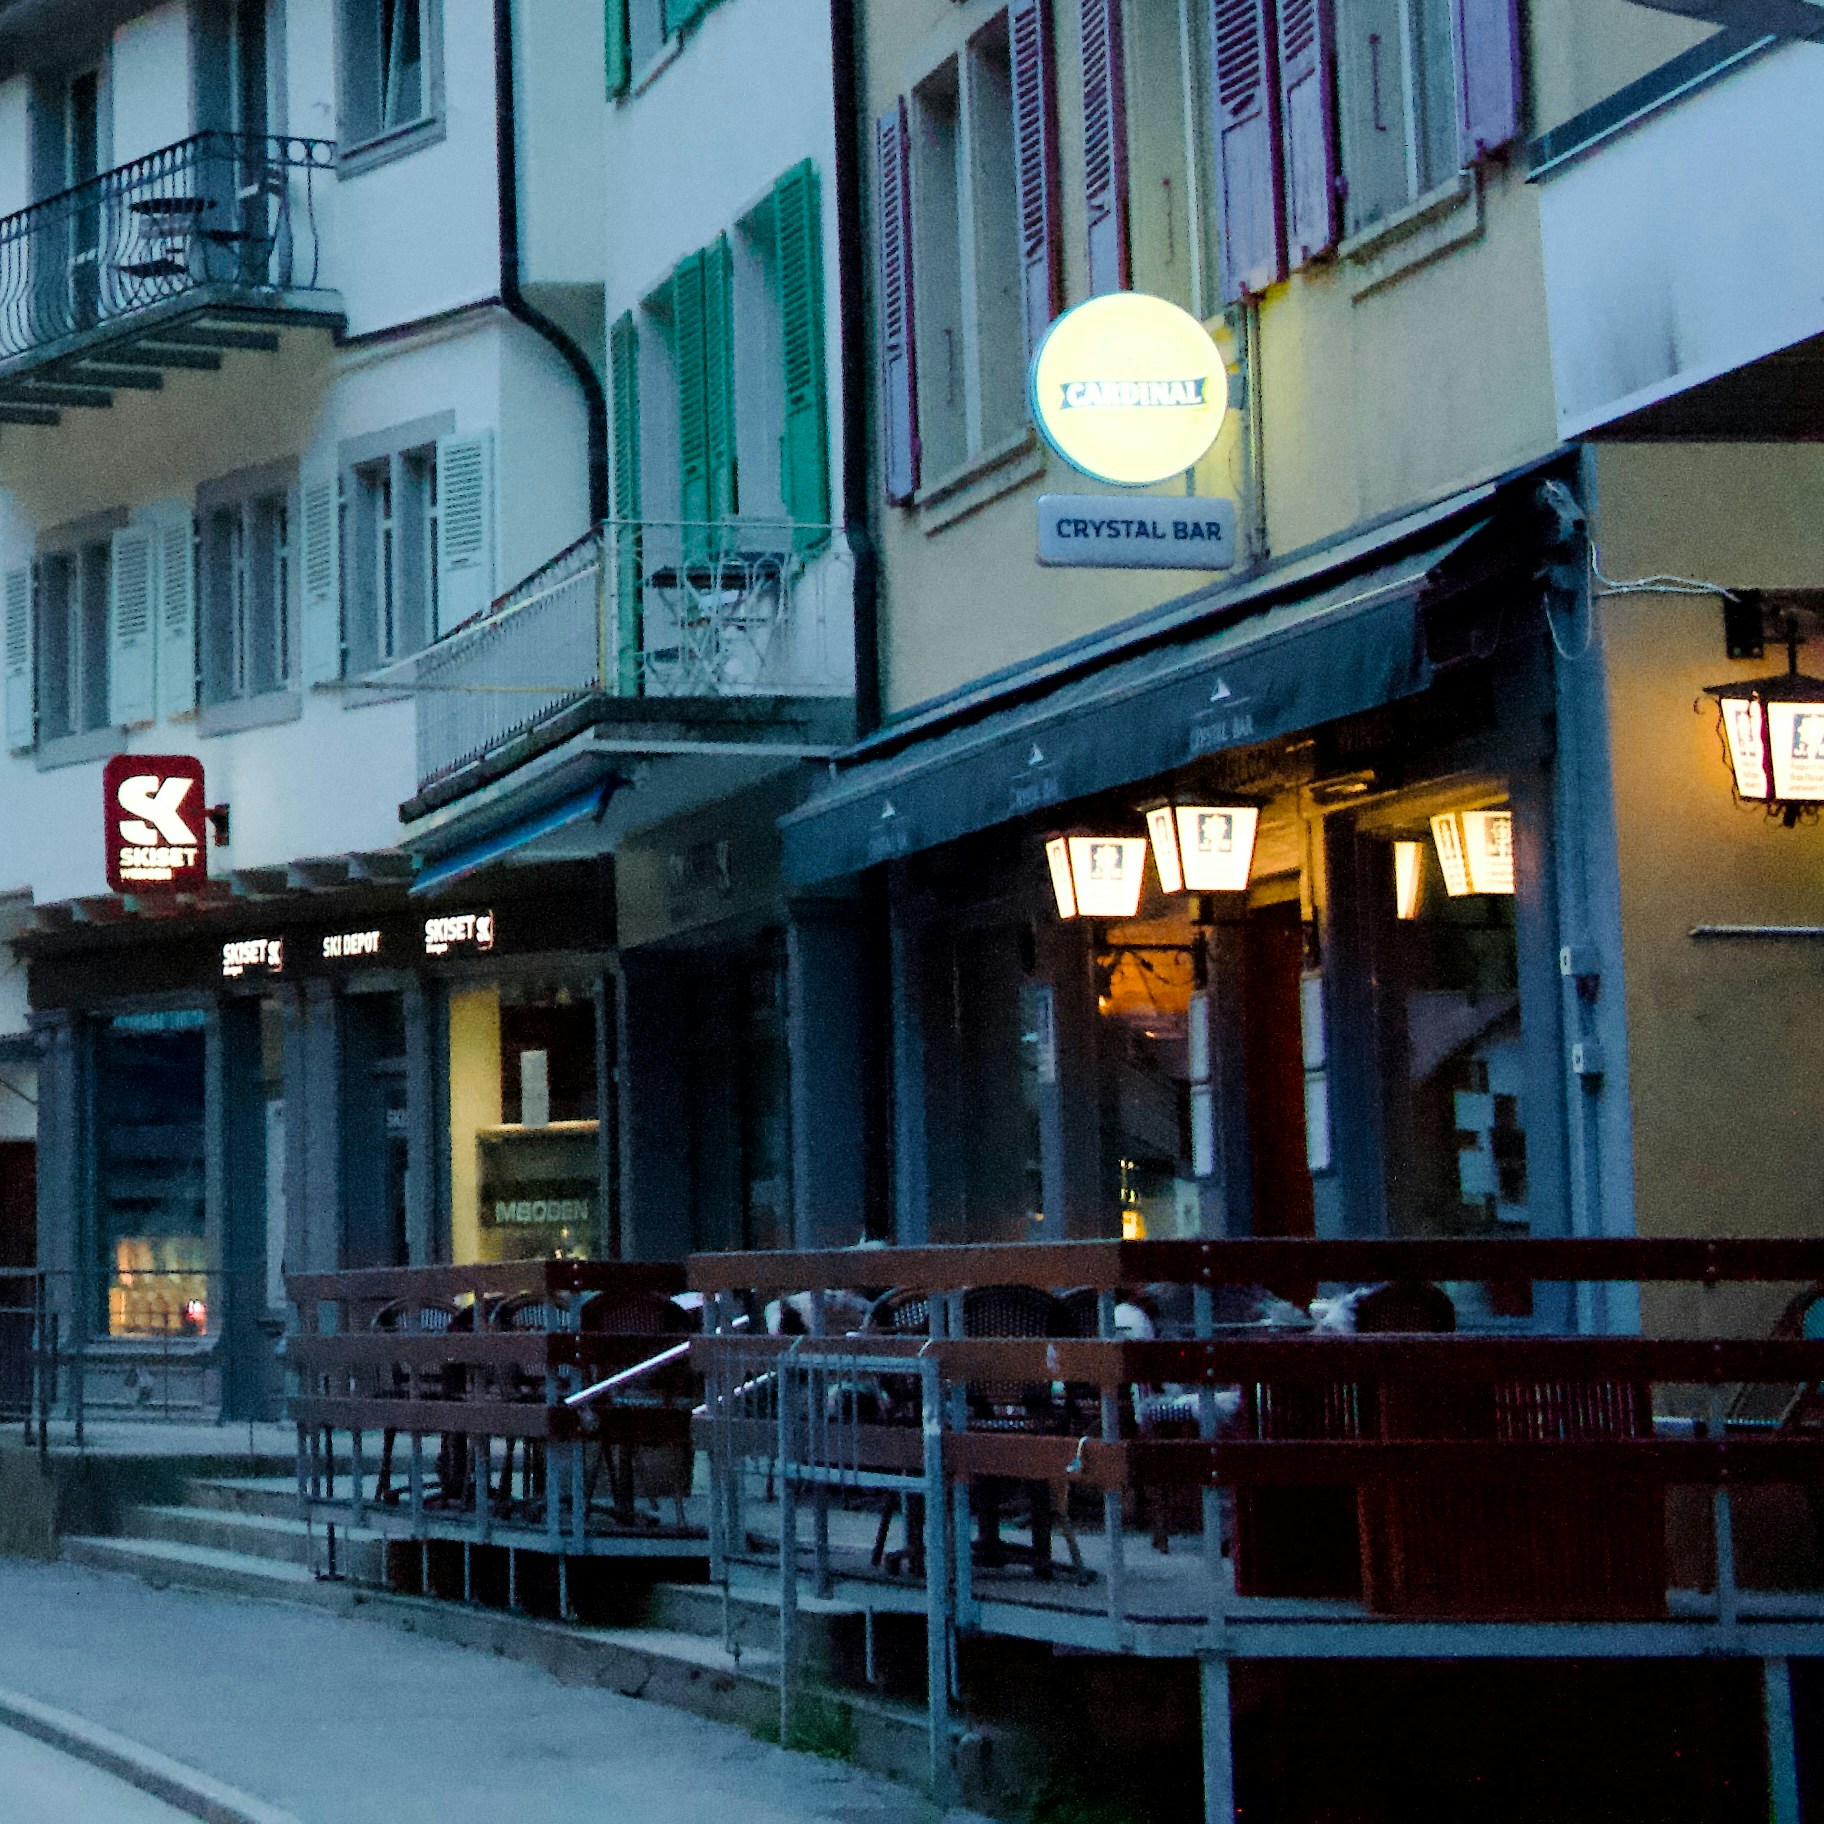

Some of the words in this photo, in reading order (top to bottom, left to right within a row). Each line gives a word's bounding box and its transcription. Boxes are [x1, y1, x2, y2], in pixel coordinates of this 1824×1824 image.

[1066, 379, 1202, 408] CARDINAL
[1056, 518, 1166, 539] CRYSTAL
[1172, 521, 1223, 541] BAR
[119, 847, 199, 867] SKISET
[425, 914, 476, 943] SKISET
[222, 938, 268, 966] SKISET
[322, 935, 342, 957] SKI
[343, 930, 381, 956] DEPOT
